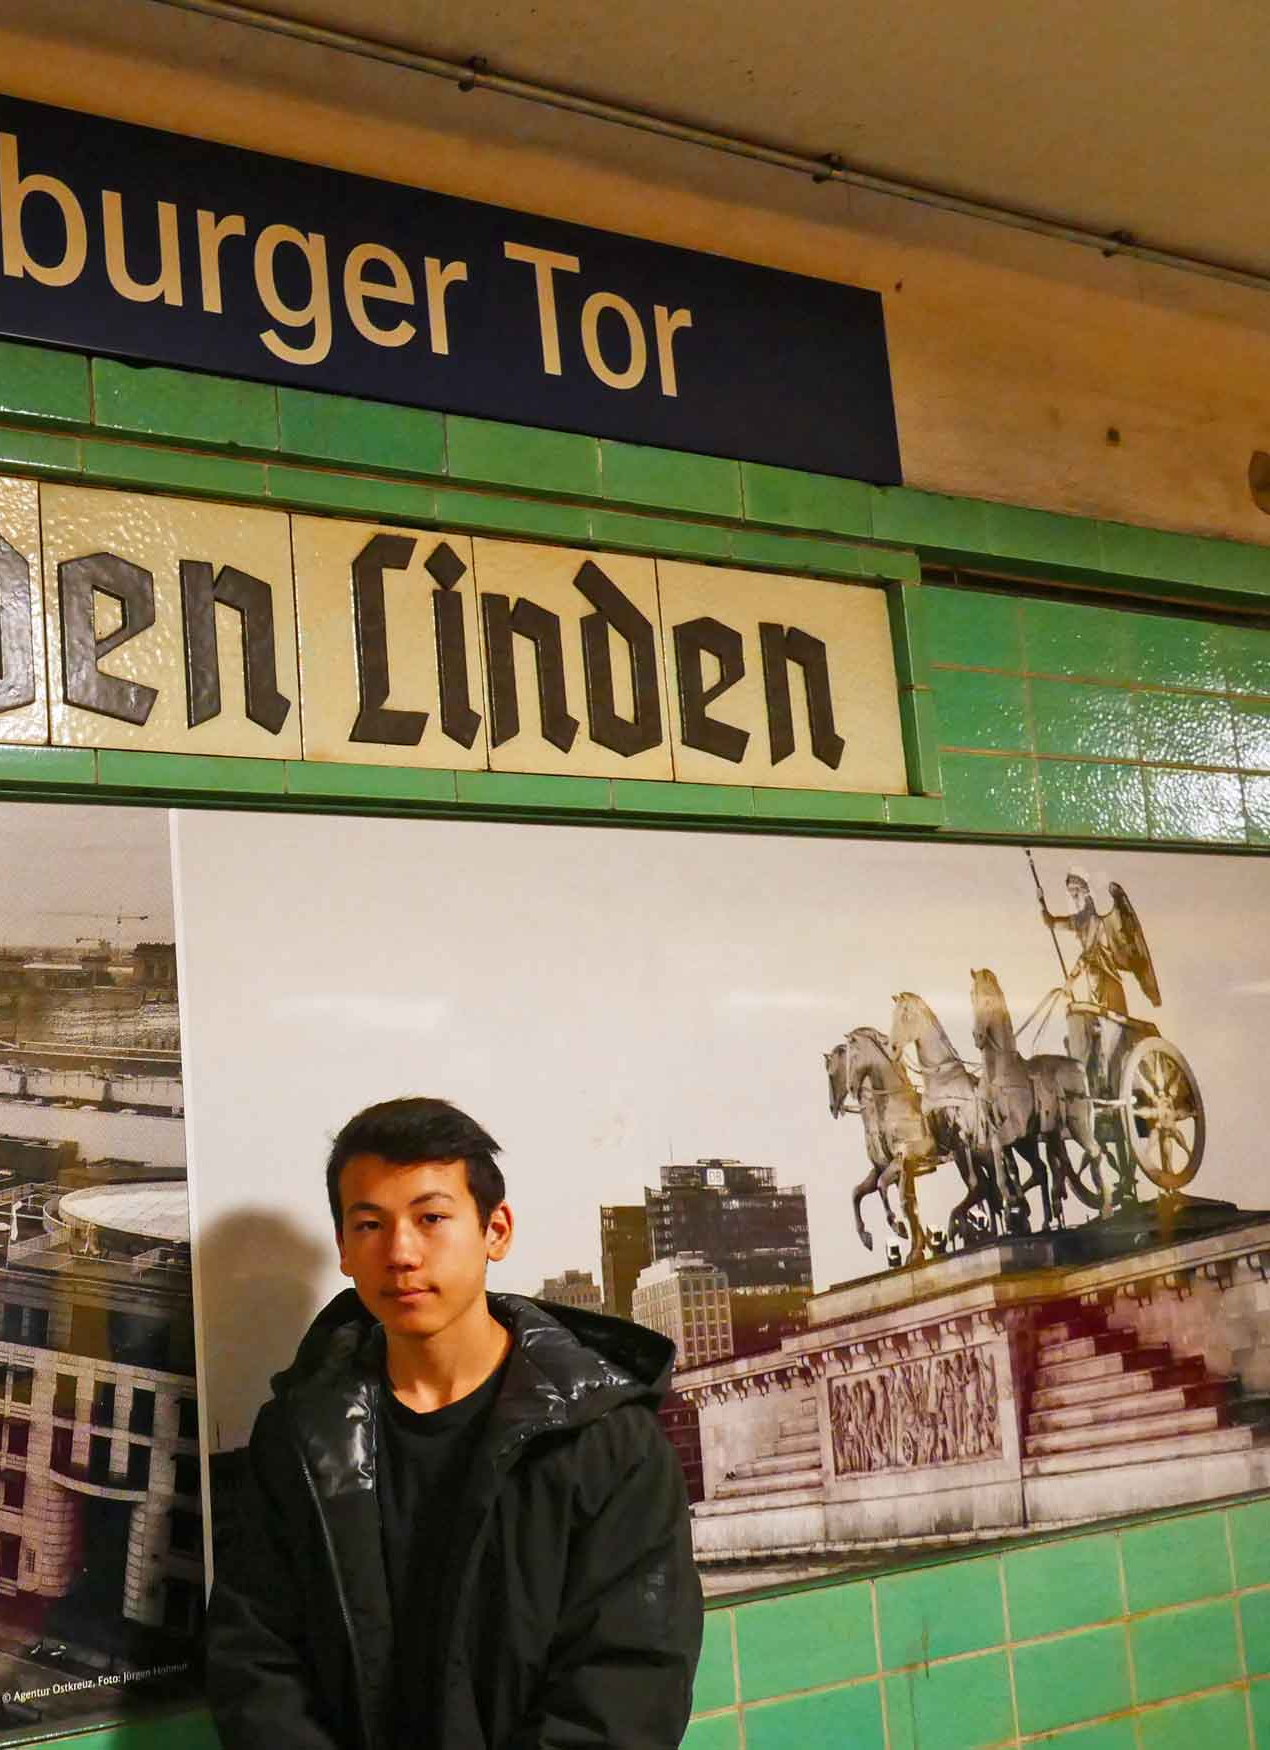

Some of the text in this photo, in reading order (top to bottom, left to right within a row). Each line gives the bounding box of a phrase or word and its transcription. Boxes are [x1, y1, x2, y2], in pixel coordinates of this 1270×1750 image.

[504, 241, 693, 397] Tor
[348, 532, 846, 771] Linden
[13, 1687, 51, 1703] Agentur
[97, 1674, 121, 1687] Foto:
